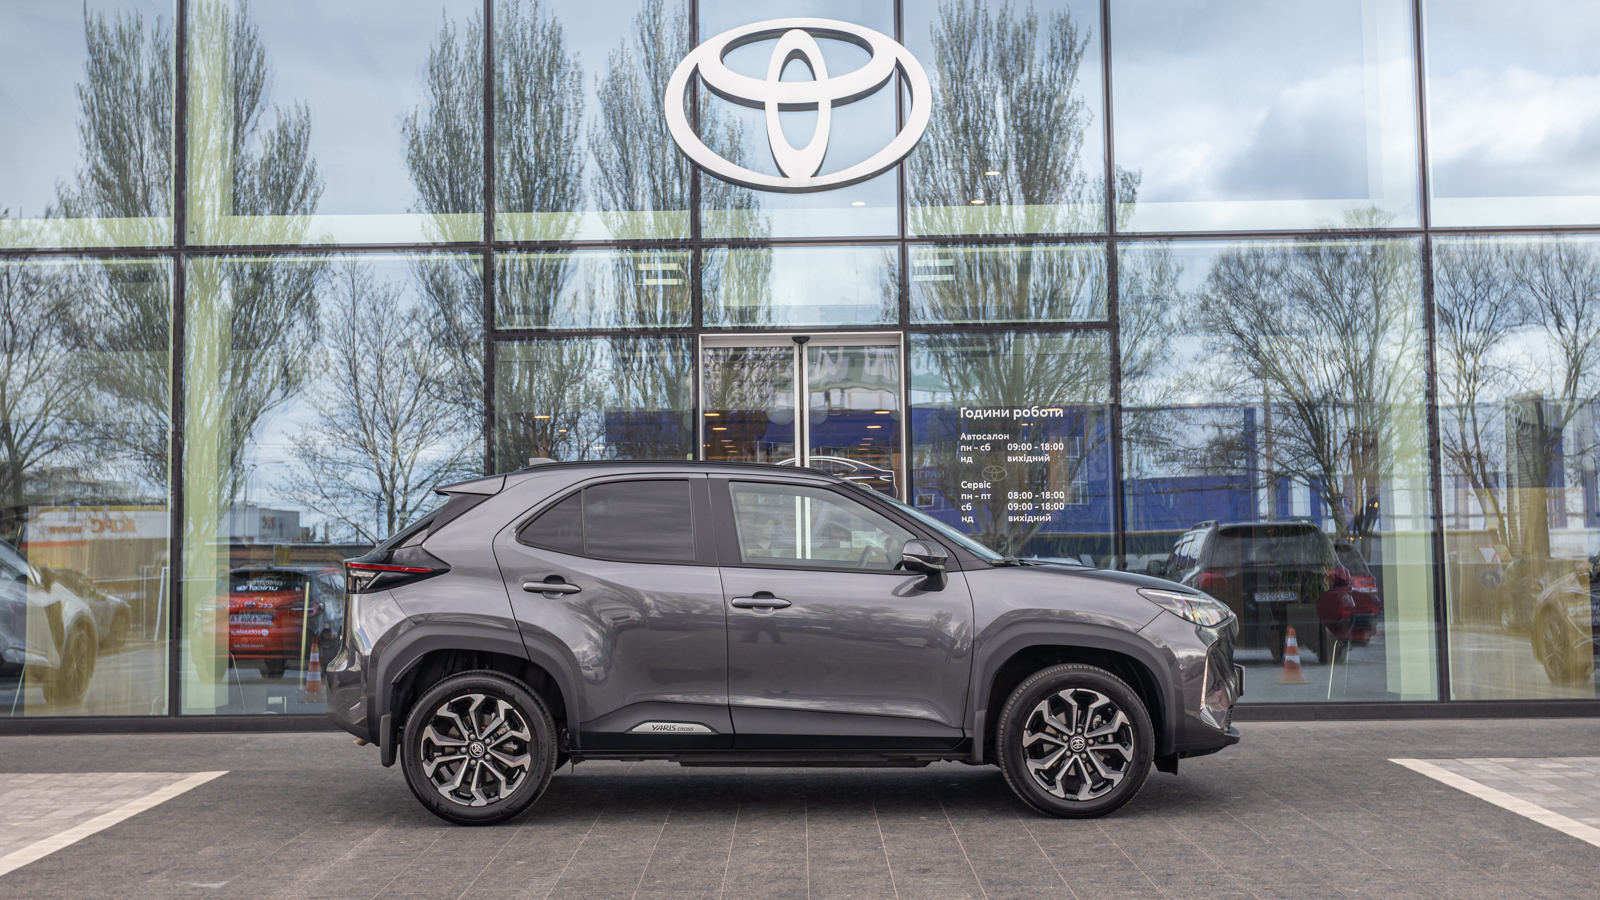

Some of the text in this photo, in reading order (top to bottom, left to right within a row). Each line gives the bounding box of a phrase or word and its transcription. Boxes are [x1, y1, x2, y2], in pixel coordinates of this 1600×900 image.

[960, 406, 1063, 420] Години роботи
[961, 454, 1050, 464] нд вихідний
[961, 481, 991, 490] Сервіс
[961, 503, 972, 511] сб
[962, 514, 1051, 523] нд вихідний
